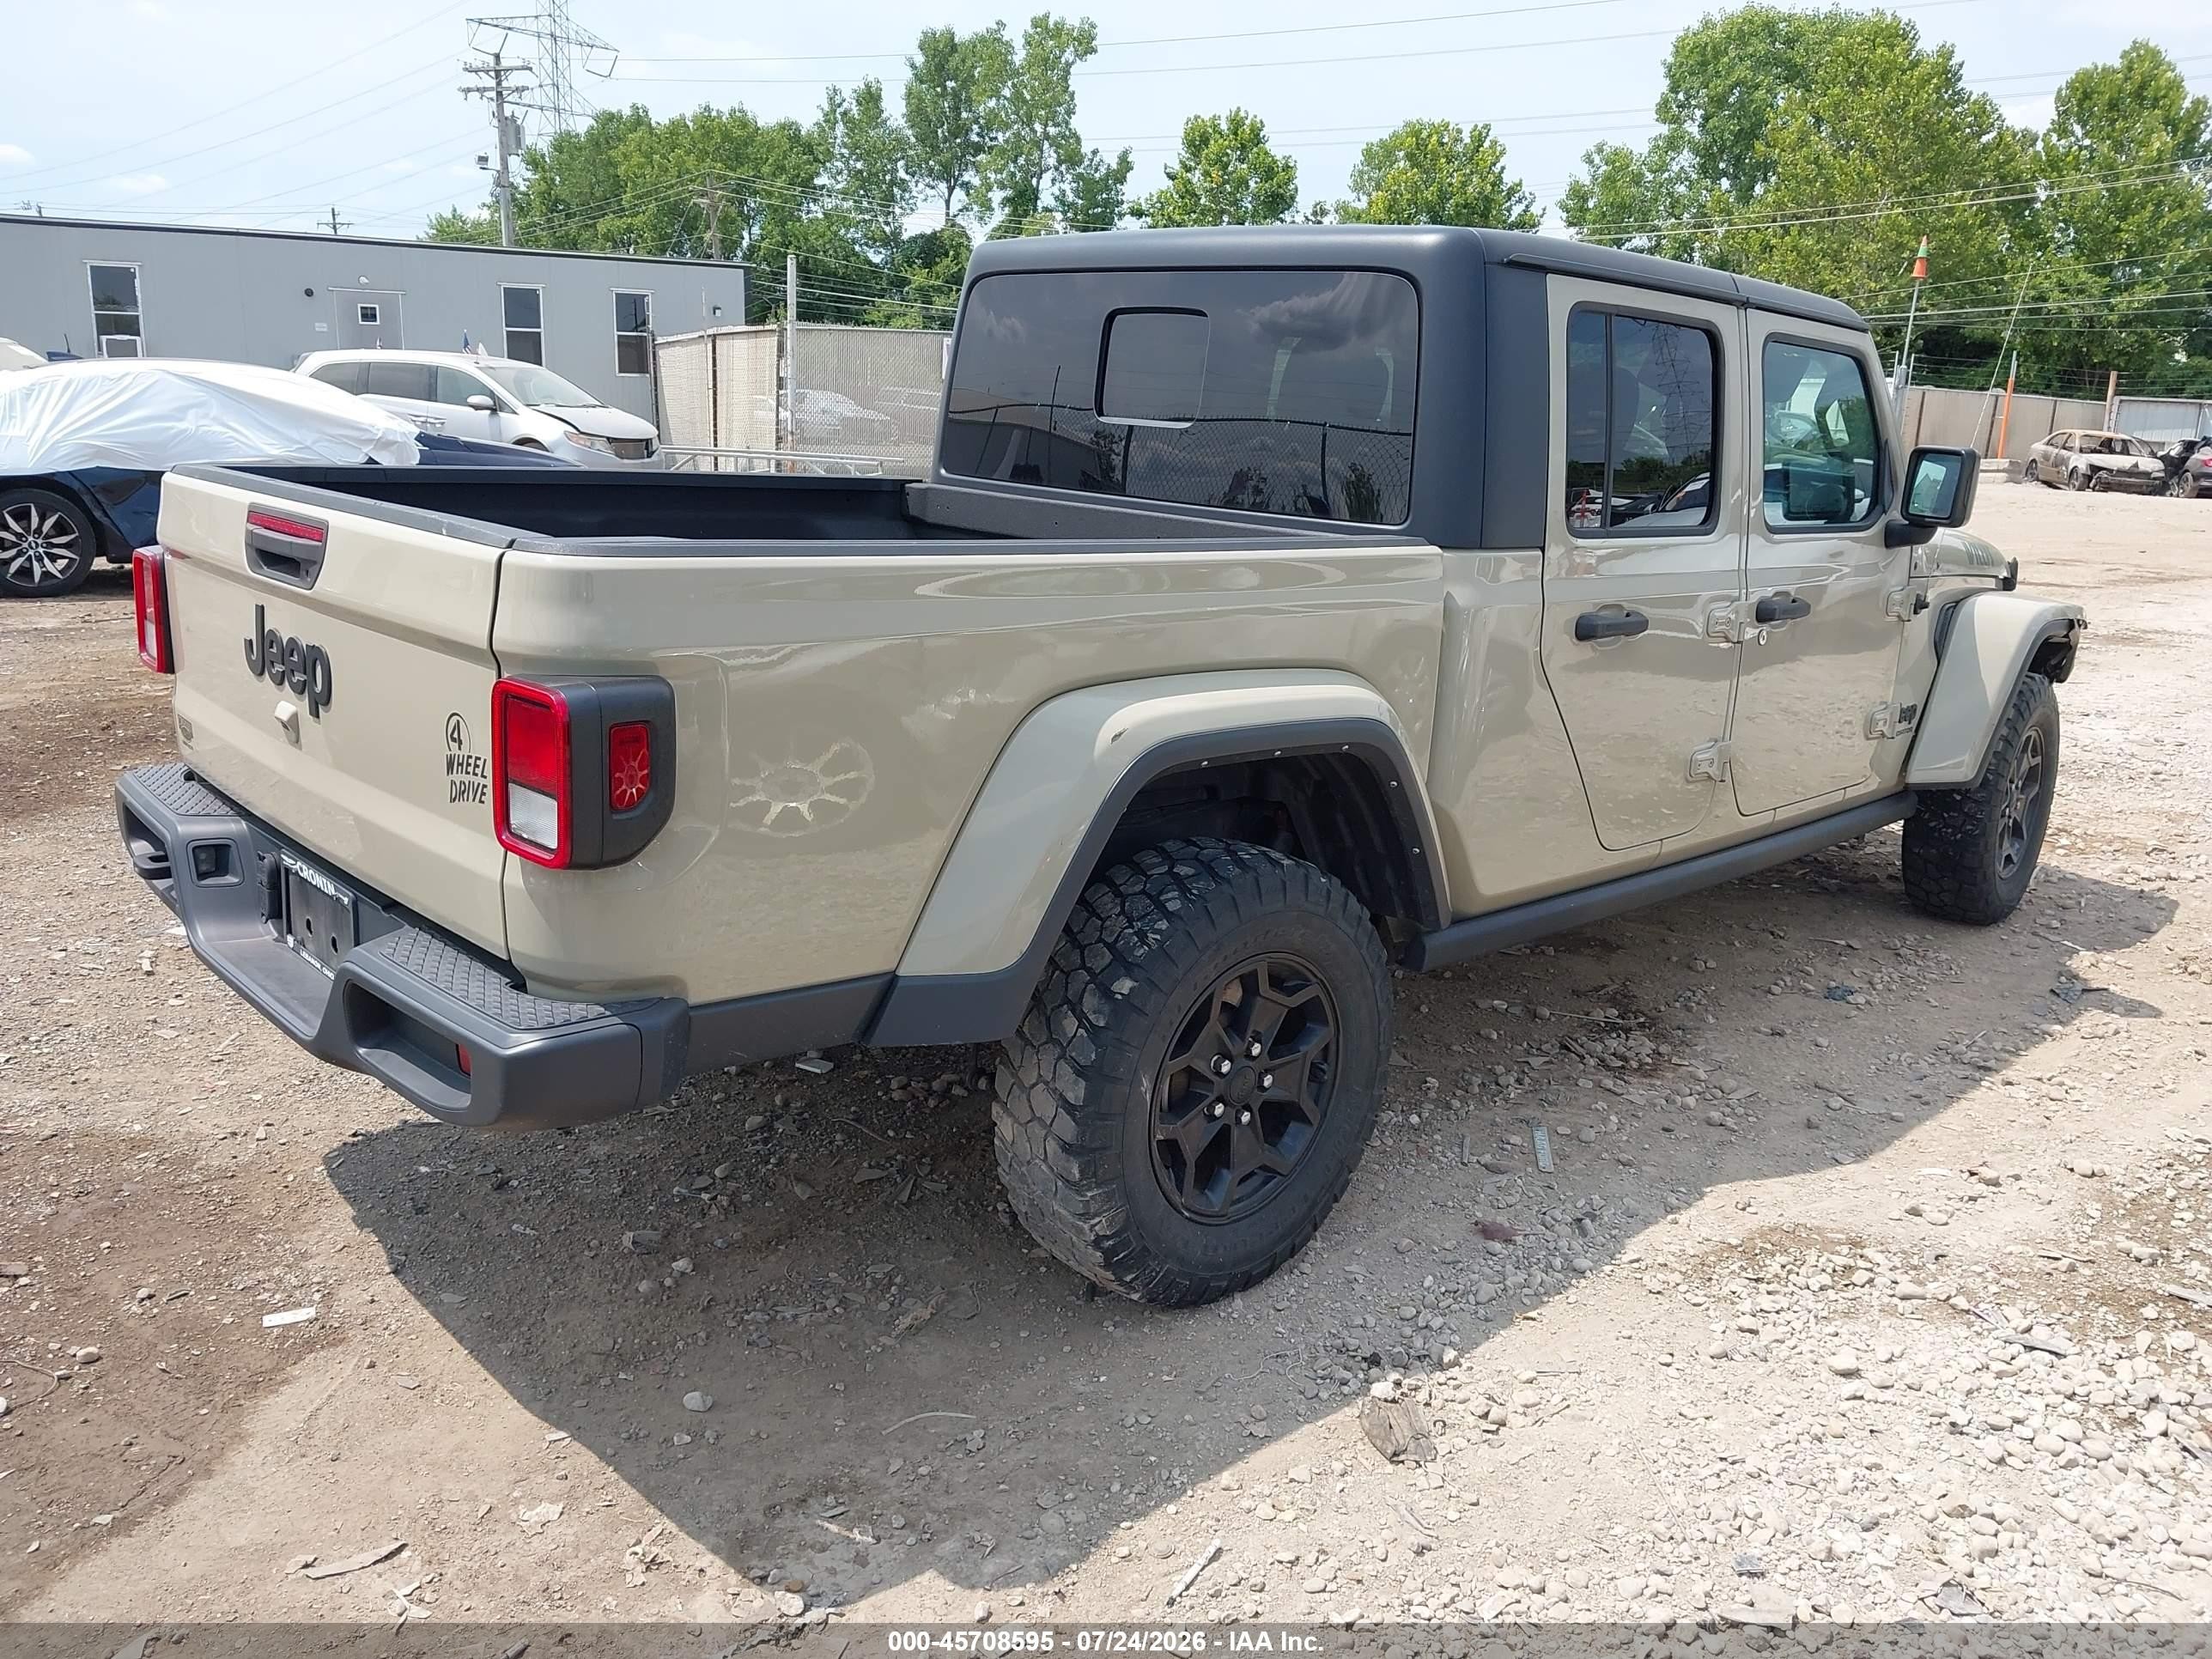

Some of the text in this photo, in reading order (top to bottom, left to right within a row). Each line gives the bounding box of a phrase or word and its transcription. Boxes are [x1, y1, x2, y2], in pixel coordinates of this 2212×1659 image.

[244, 604, 332, 719] Jeep
[449, 719, 464, 751] 4
[446, 753, 488, 780] WHEEL
[449, 779, 488, 805] DRIVE
[296, 861, 336, 896] CRONIN
